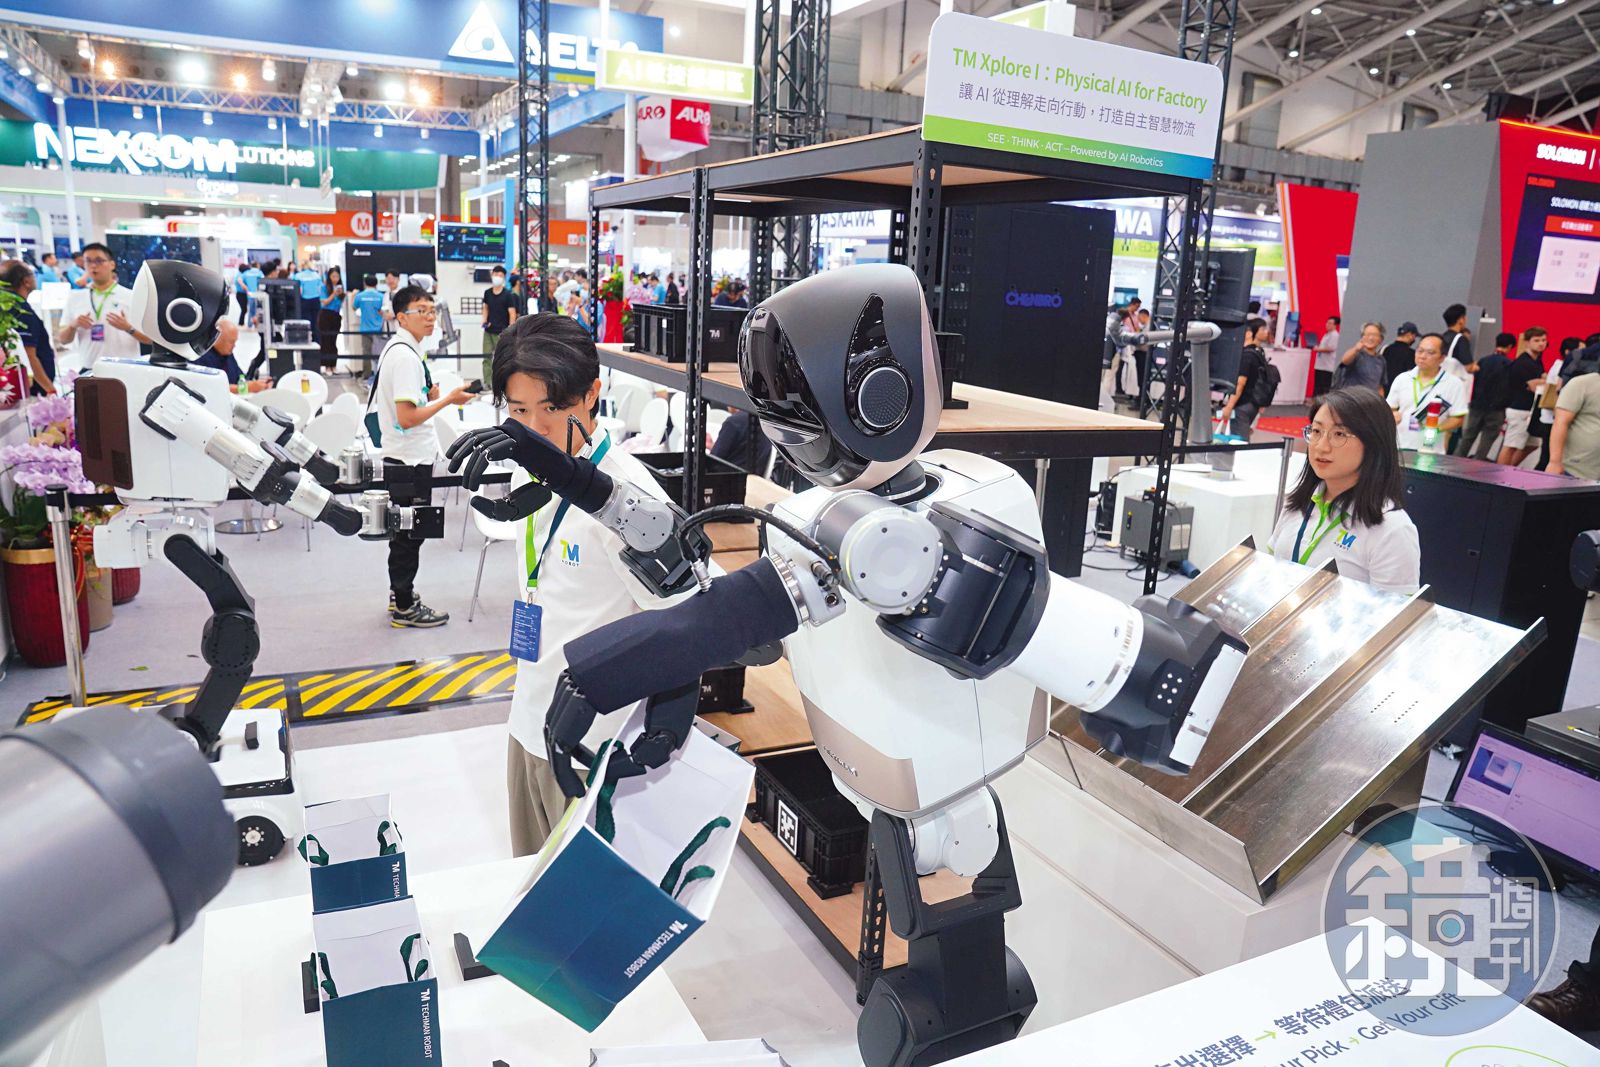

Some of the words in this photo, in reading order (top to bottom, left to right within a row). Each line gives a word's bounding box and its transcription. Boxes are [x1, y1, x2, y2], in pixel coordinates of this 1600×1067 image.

[952, 47, 977, 69] TM
[980, 52, 1031, 79] Xplore
[1055, 67, 1115, 94] Physical
[1117, 80, 1132, 97] AI
[1134, 82, 1154, 100] for
[1157, 86, 1207, 114] Factory
[959, 81, 973, 101] 讓
[976, 86, 989, 102] AI
[33, 121, 237, 176] NEXCOM
[987, 132, 1005, 144] SEE
[1011, 136, 1040, 149] THINK
[1108, 149, 1119, 162] by
[1119, 154, 1128, 162] AI
[1130, 154, 1164, 168] Robotics
[1536, 143, 1586, 165] SOLOMON
[357, 218, 370, 231] M
[1336, 529, 1356, 547] TM
[560, 539, 580, 562] TM
[391, 860, 400, 873] TM
[669, 919, 689, 935] TM
[641, 930, 675, 960] TECHMAN
[624, 956, 647, 978] ROBOT
[420, 988, 430, 1002] TM
[421, 1003, 431, 1035] TECHMAN
[1300, 1039, 1350, 1064] Pick
[1357, 1021, 1397, 1040] Get
[1387, 1005, 1433, 1027] Your
[1428, 992, 1466, 1011] Gift
[424, 1036, 433, 1059] ROBOT
